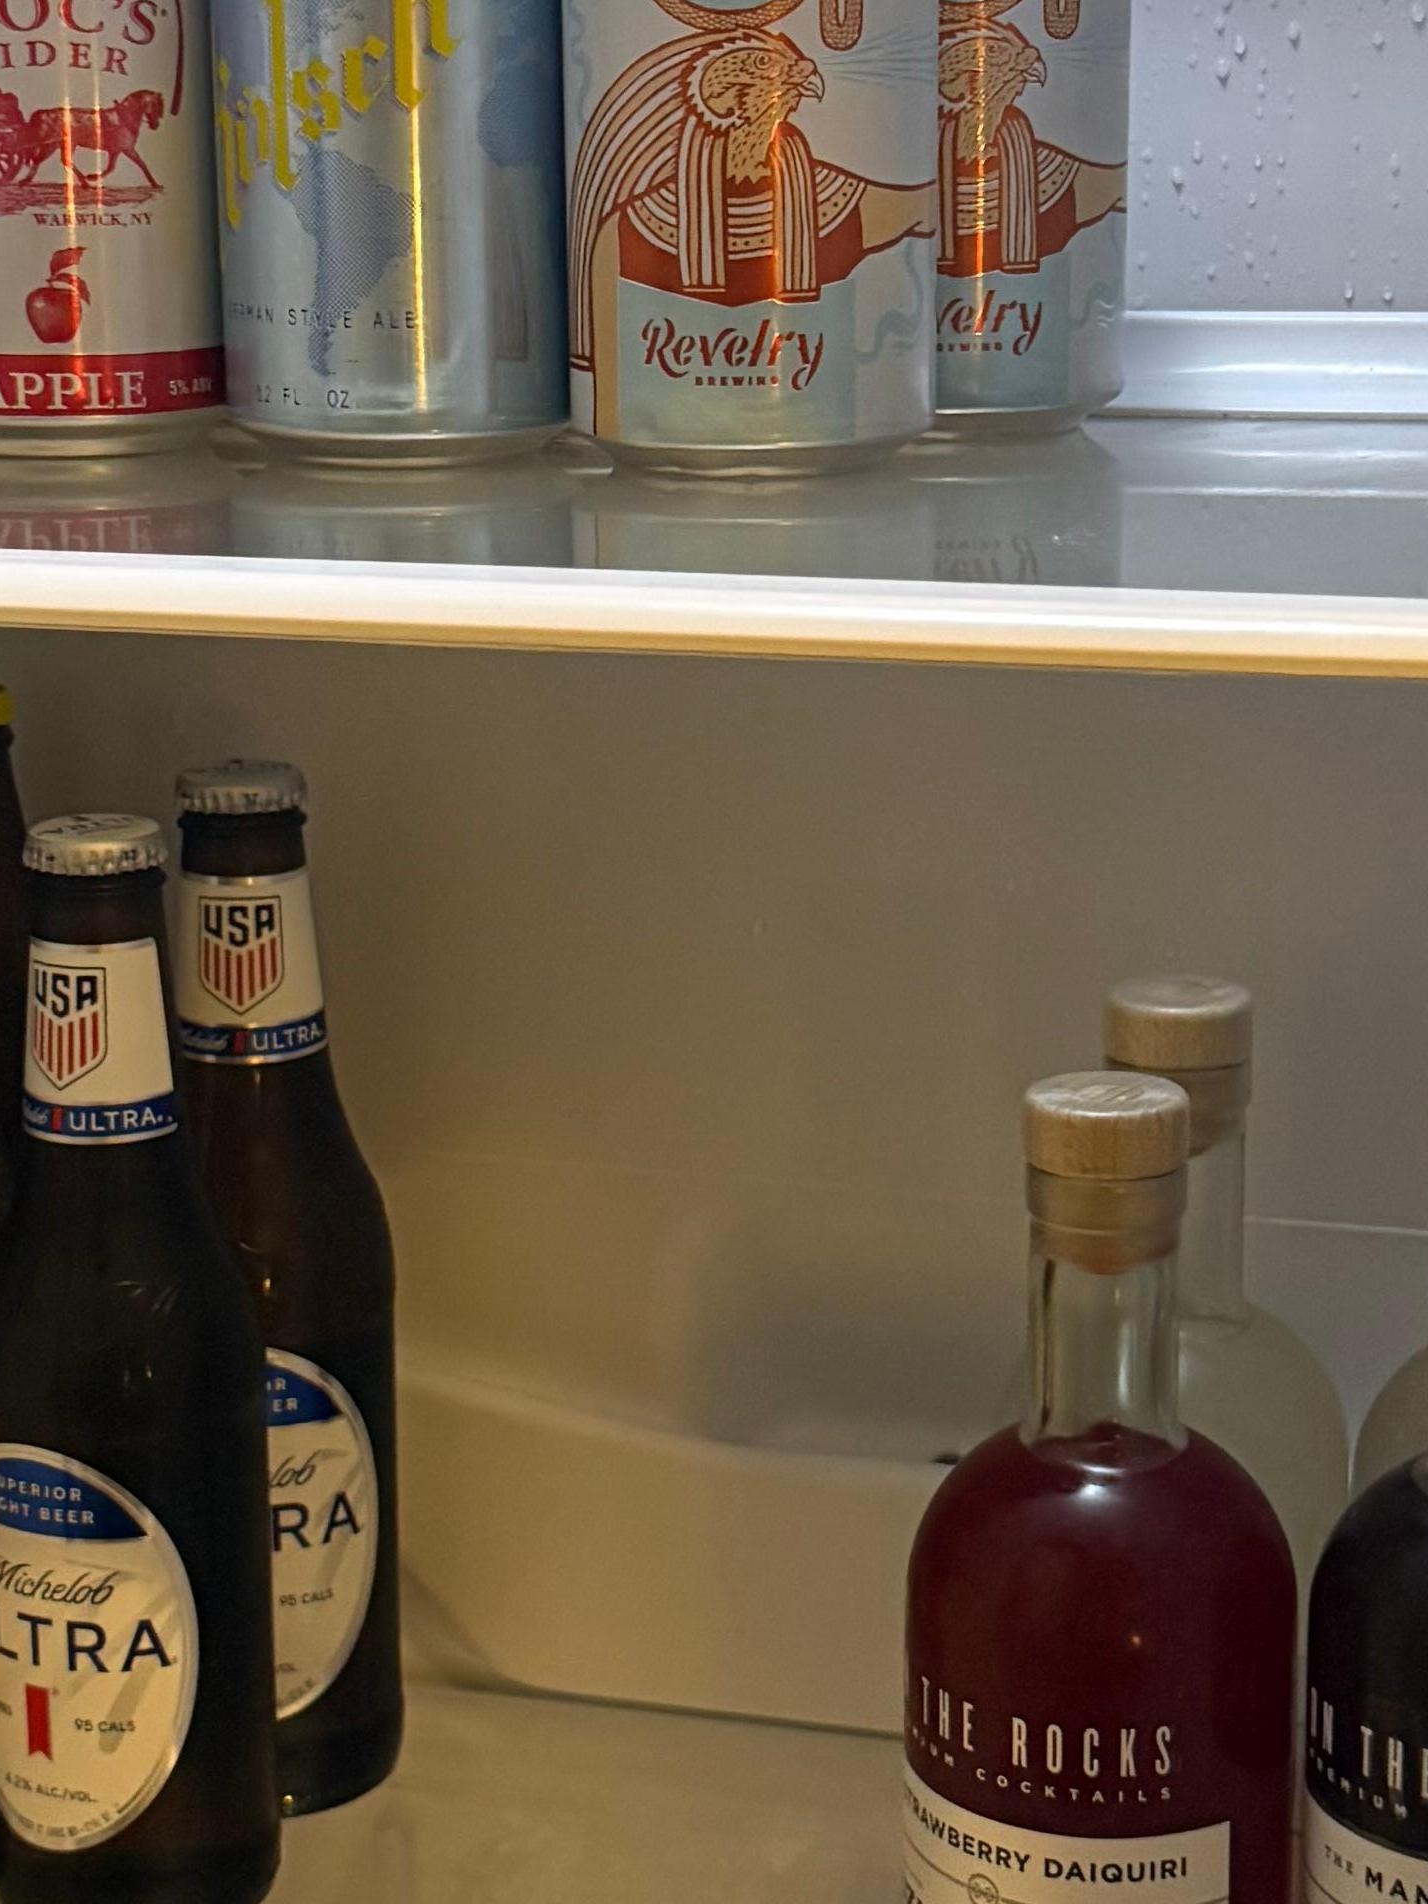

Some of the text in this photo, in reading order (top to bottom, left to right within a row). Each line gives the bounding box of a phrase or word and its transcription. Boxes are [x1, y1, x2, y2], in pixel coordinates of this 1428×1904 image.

[130, 212, 154, 227] NY
[373, 311, 418, 329] ALE
[640, 316, 825, 392] Revelry
[694, 375, 780, 387] BREWING
[326, 389, 350, 409] OZ
[203, 902, 275, 948] USA
[33, 967, 98, 1019] USA
[252, 1022, 322, 1053] ULTRA
[70, 1106, 157, 1132] ULTRA
[38, 1505, 96, 1526] BEER
[74, 1718, 137, 1734] 95 CALS
[920, 1674, 975, 1753] THE
[1010, 1716, 1172, 1780] ROCKS
[975, 1767, 1172, 1804] COCKTAILS
[1043, 1856, 1188, 1884] DAIQUIRI
[1324, 1843, 1355, 1876] THE
